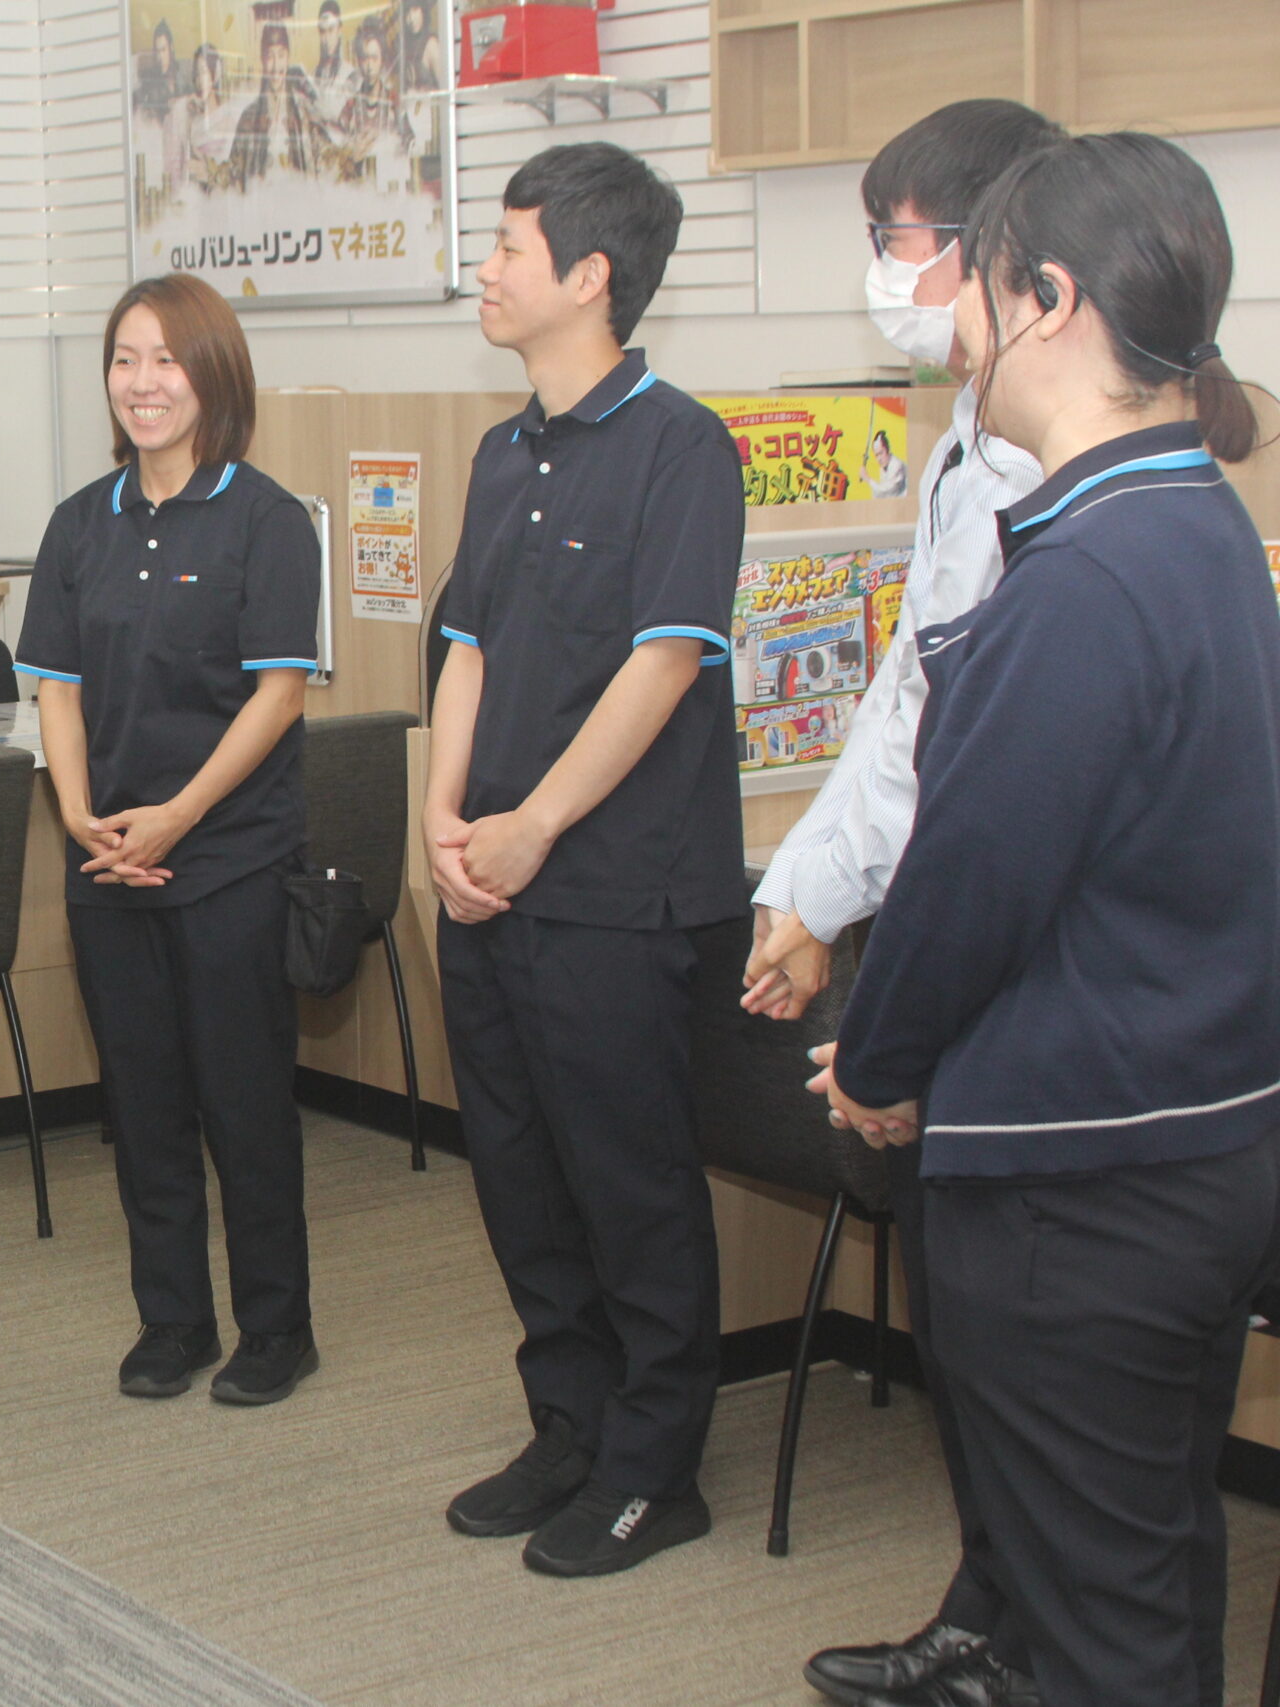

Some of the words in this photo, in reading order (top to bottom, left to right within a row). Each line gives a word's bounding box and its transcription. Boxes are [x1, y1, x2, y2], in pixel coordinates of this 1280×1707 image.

[170, 227, 323, 270] auバリューリンク
[328, 219, 407, 261] マネ活2
[750, 566, 850, 612] エンタメフェア
